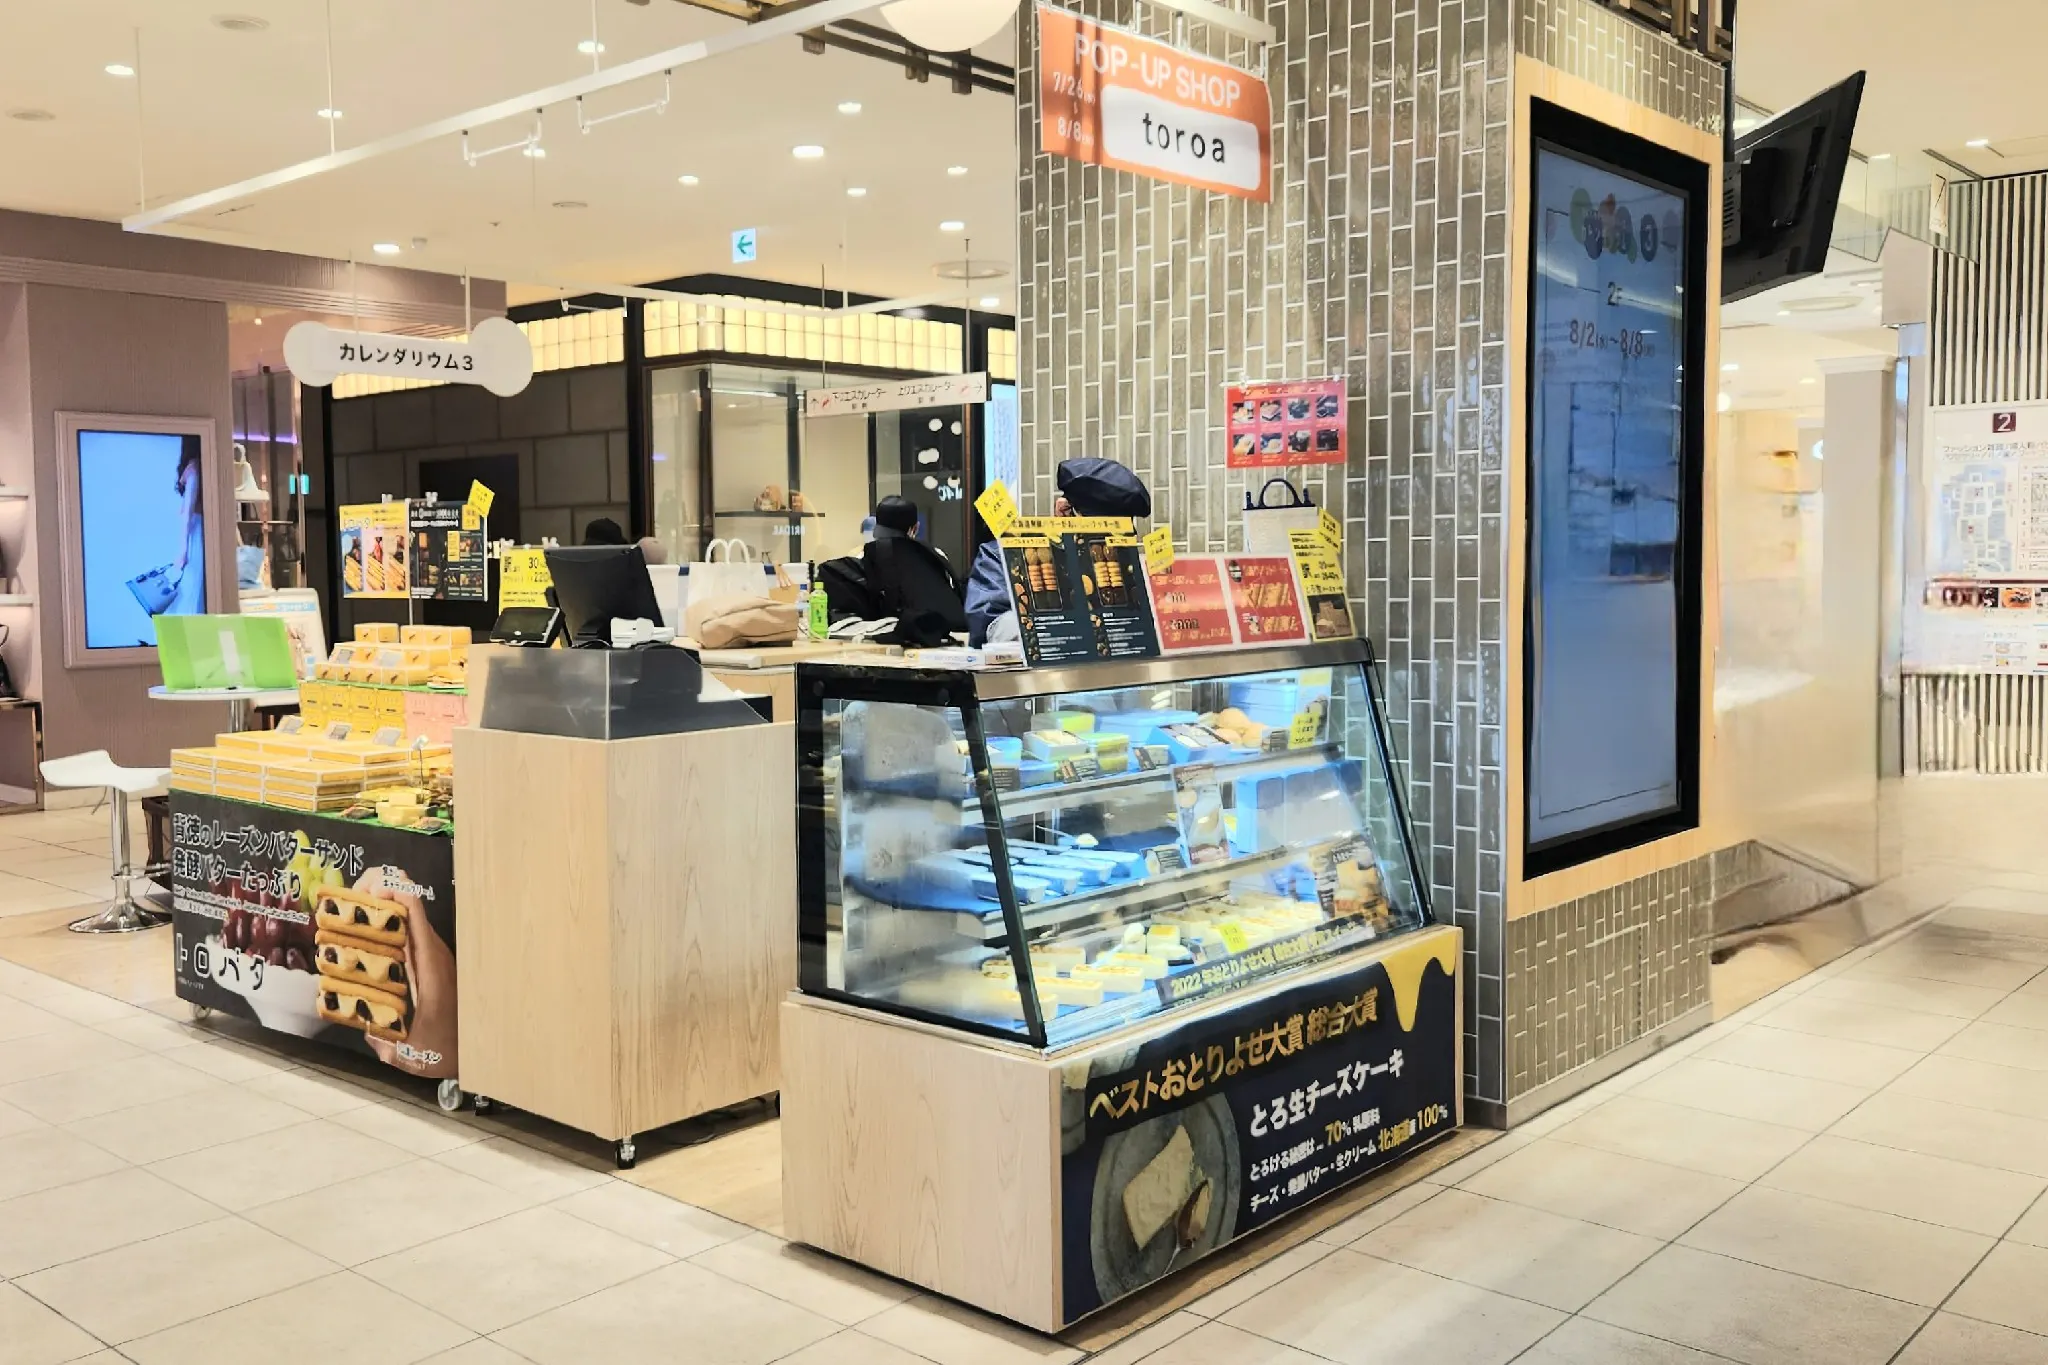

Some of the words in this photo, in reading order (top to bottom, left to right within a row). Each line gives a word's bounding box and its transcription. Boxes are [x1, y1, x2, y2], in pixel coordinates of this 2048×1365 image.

[1074, 32, 1172, 90] POP-UP
[1175, 66, 1241, 109] SHOP
[1142, 112, 1226, 164] toroa
[339, 342, 474, 371] カレンダリウム3
[173, 812, 365, 876] 背徳のレーズンバターサンド
[173, 846, 303, 900] 発酵バターたっぷり
[176, 932, 266, 991] トロバタ
[1089, 1013, 1305, 1120] ベストおとりよせ大賞
[1306, 987, 1379, 1045] 総合大賞
[1250, 1048, 1405, 1138] とろ生チーズケーキ
[1416, 1102, 1448, 1131] 100%
